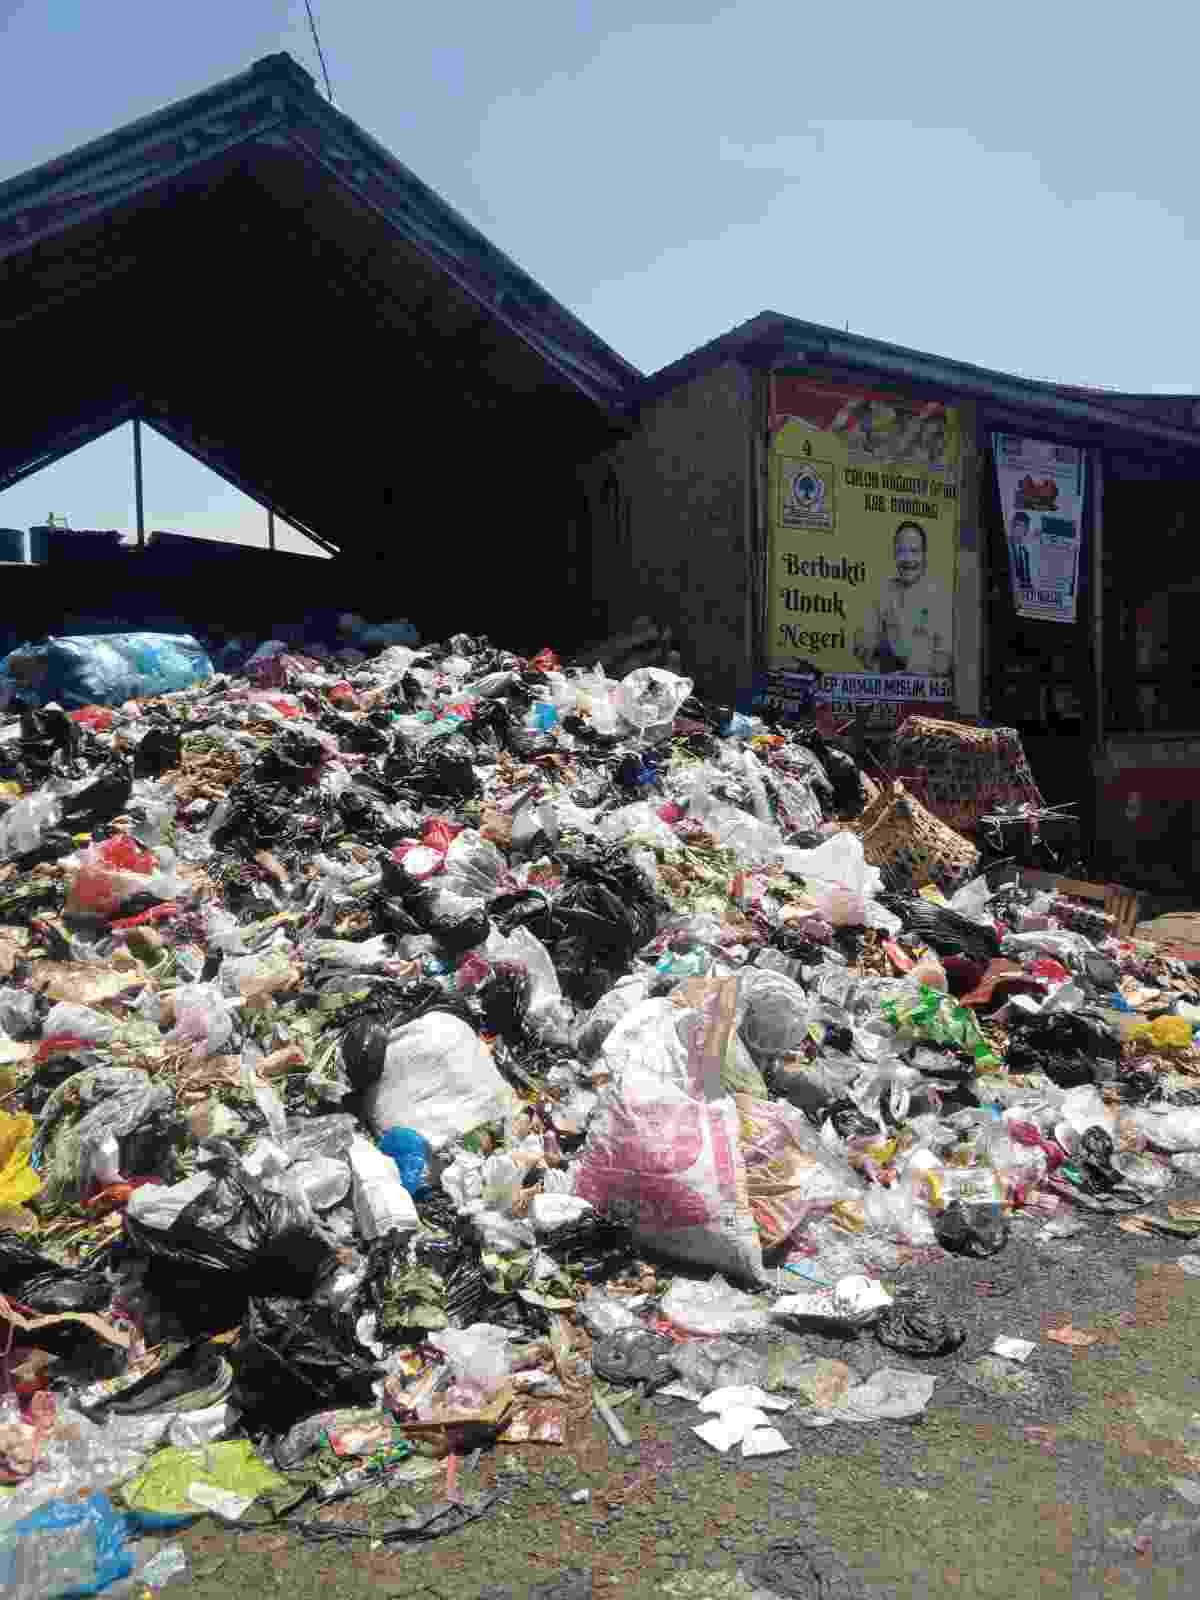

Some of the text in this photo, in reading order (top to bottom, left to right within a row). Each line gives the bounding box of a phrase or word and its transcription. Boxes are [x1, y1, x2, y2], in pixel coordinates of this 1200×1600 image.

[781, 552, 865, 586] Berbakti
[779, 585, 847, 620] Untuk
[777, 624, 845, 655] Negeri
